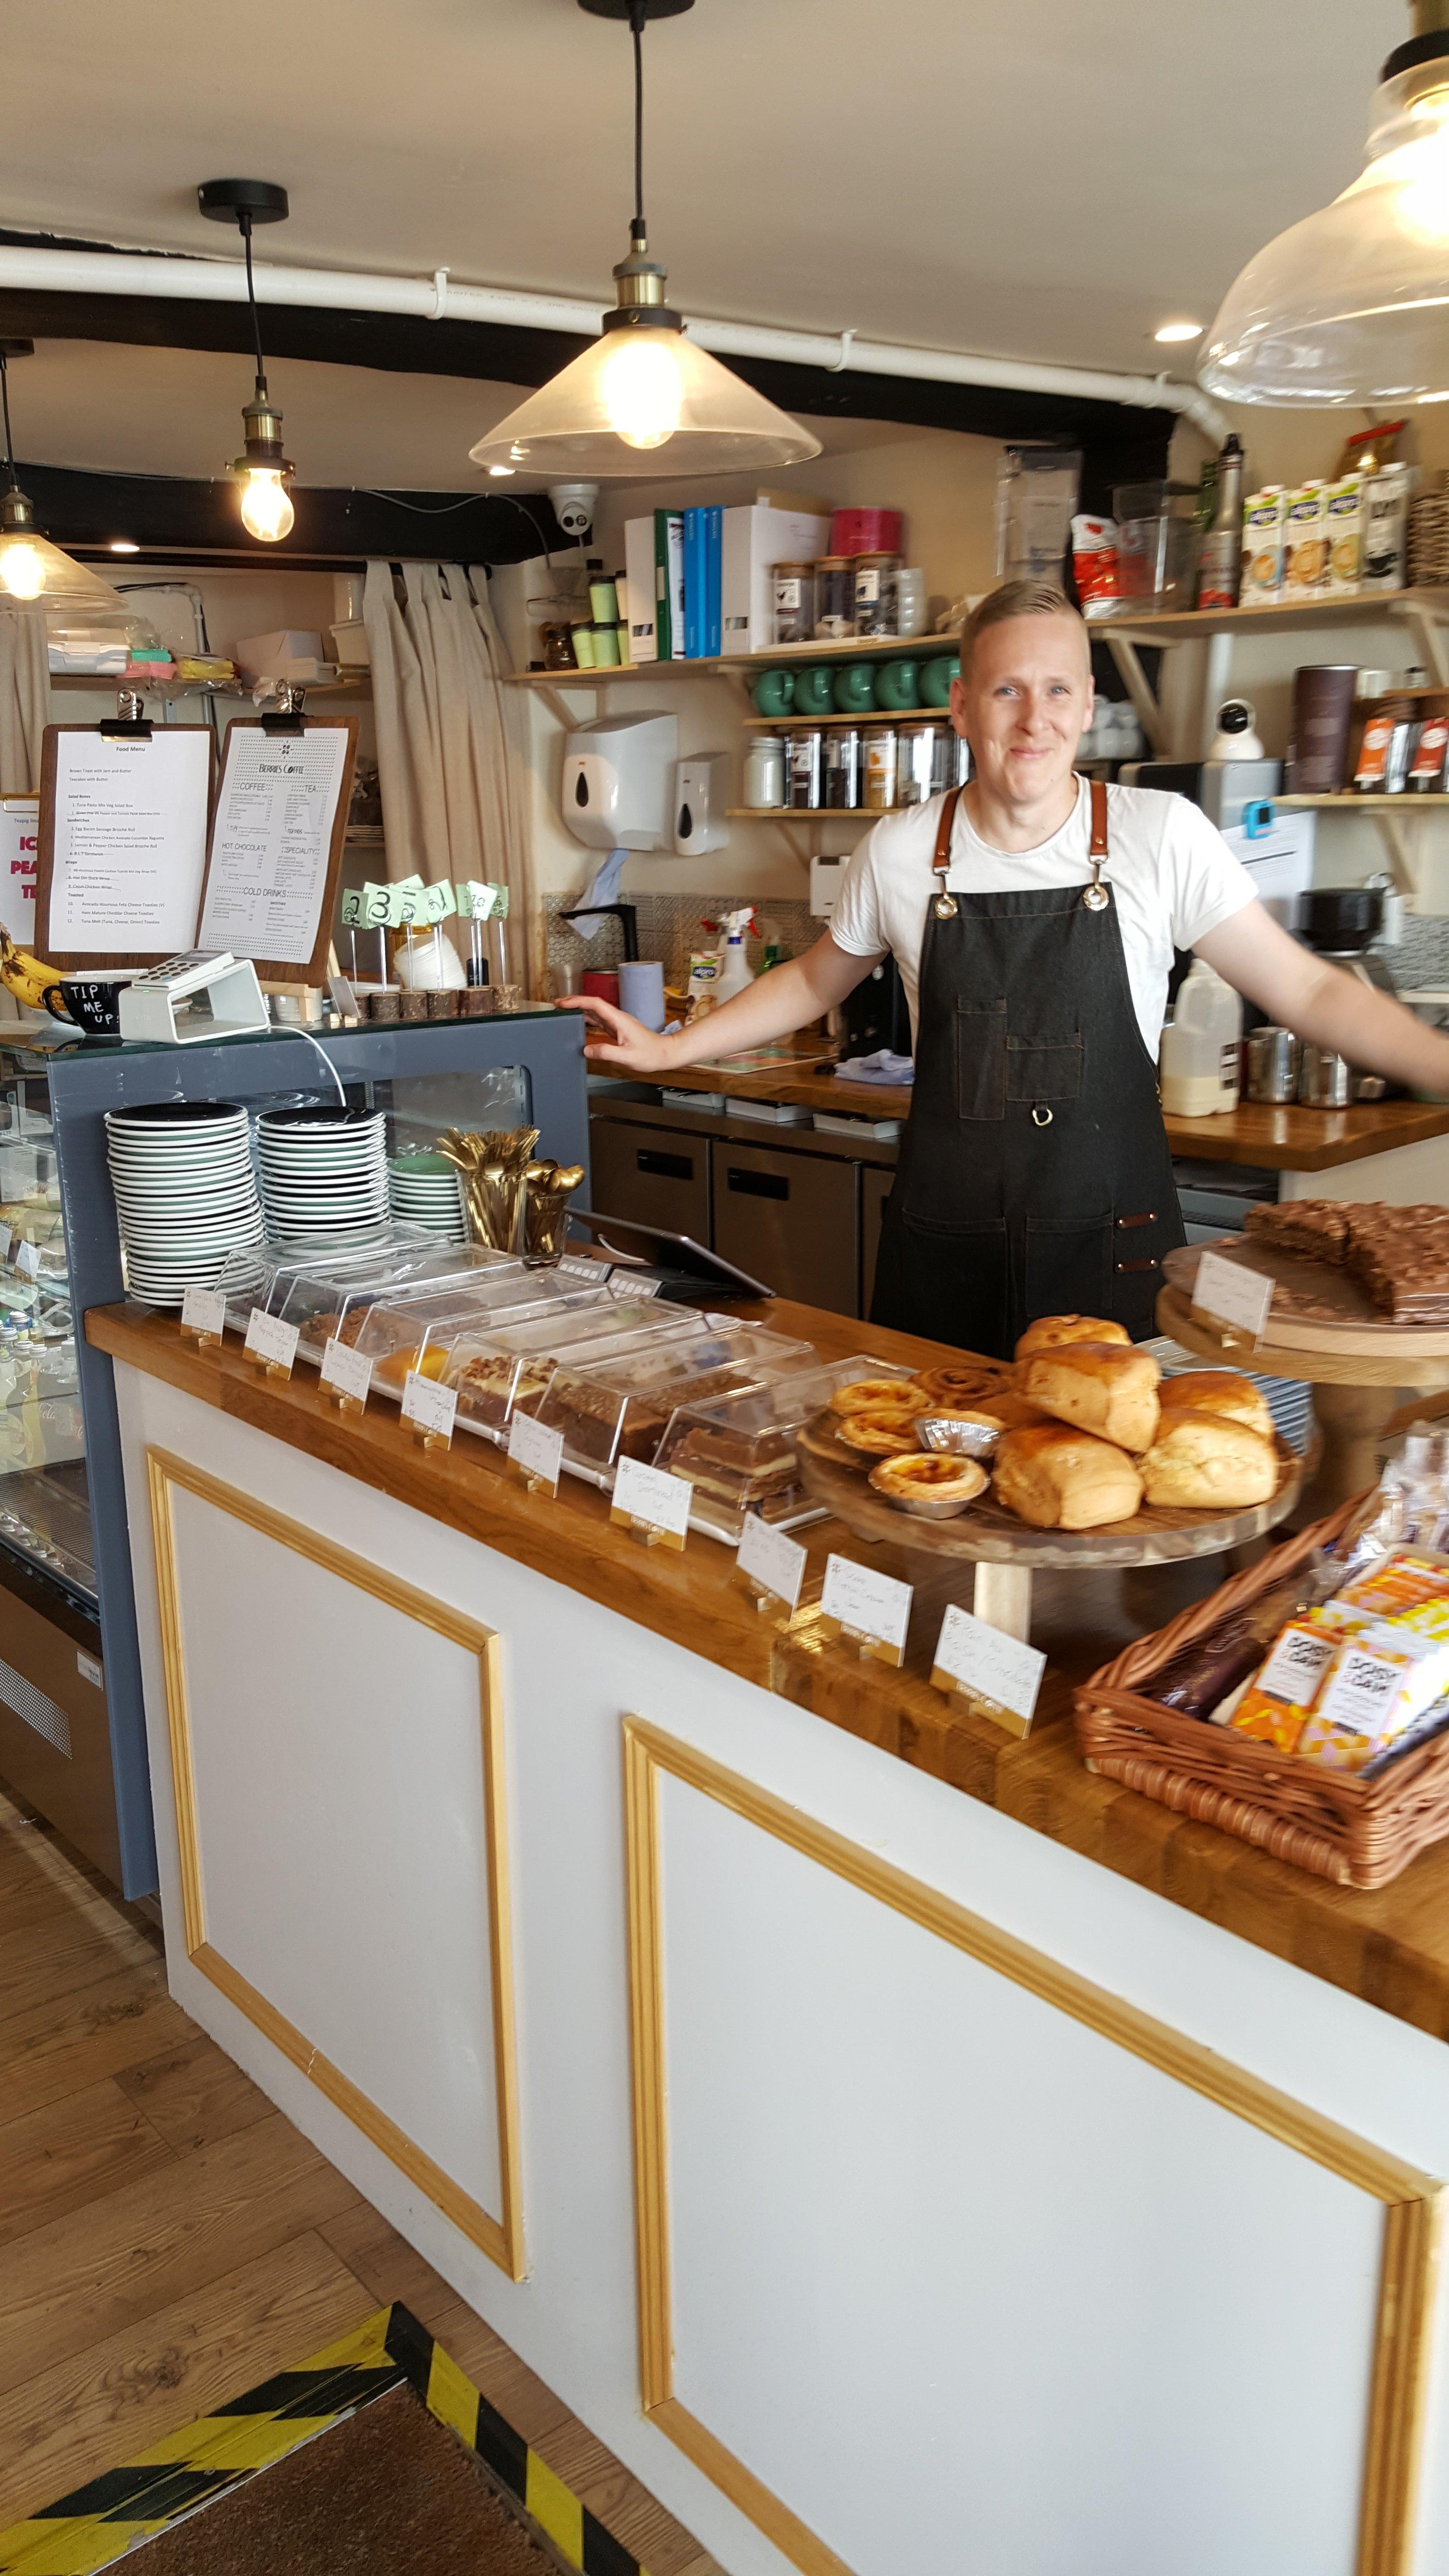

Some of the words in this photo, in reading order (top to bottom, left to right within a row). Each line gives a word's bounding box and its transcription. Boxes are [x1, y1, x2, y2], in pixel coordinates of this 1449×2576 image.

[258, 764, 282, 773] BERRIES
[240, 783, 266, 791] COFFEE
[20, 837, 37, 850] IC
[235, 843, 267, 852] CHOCOLATE
[243, 887, 261, 896] COLD
[263, 888, 286, 898] DRINKS
[70, 984, 98, 999] TIP
[83, 1001, 104, 1013] ME
